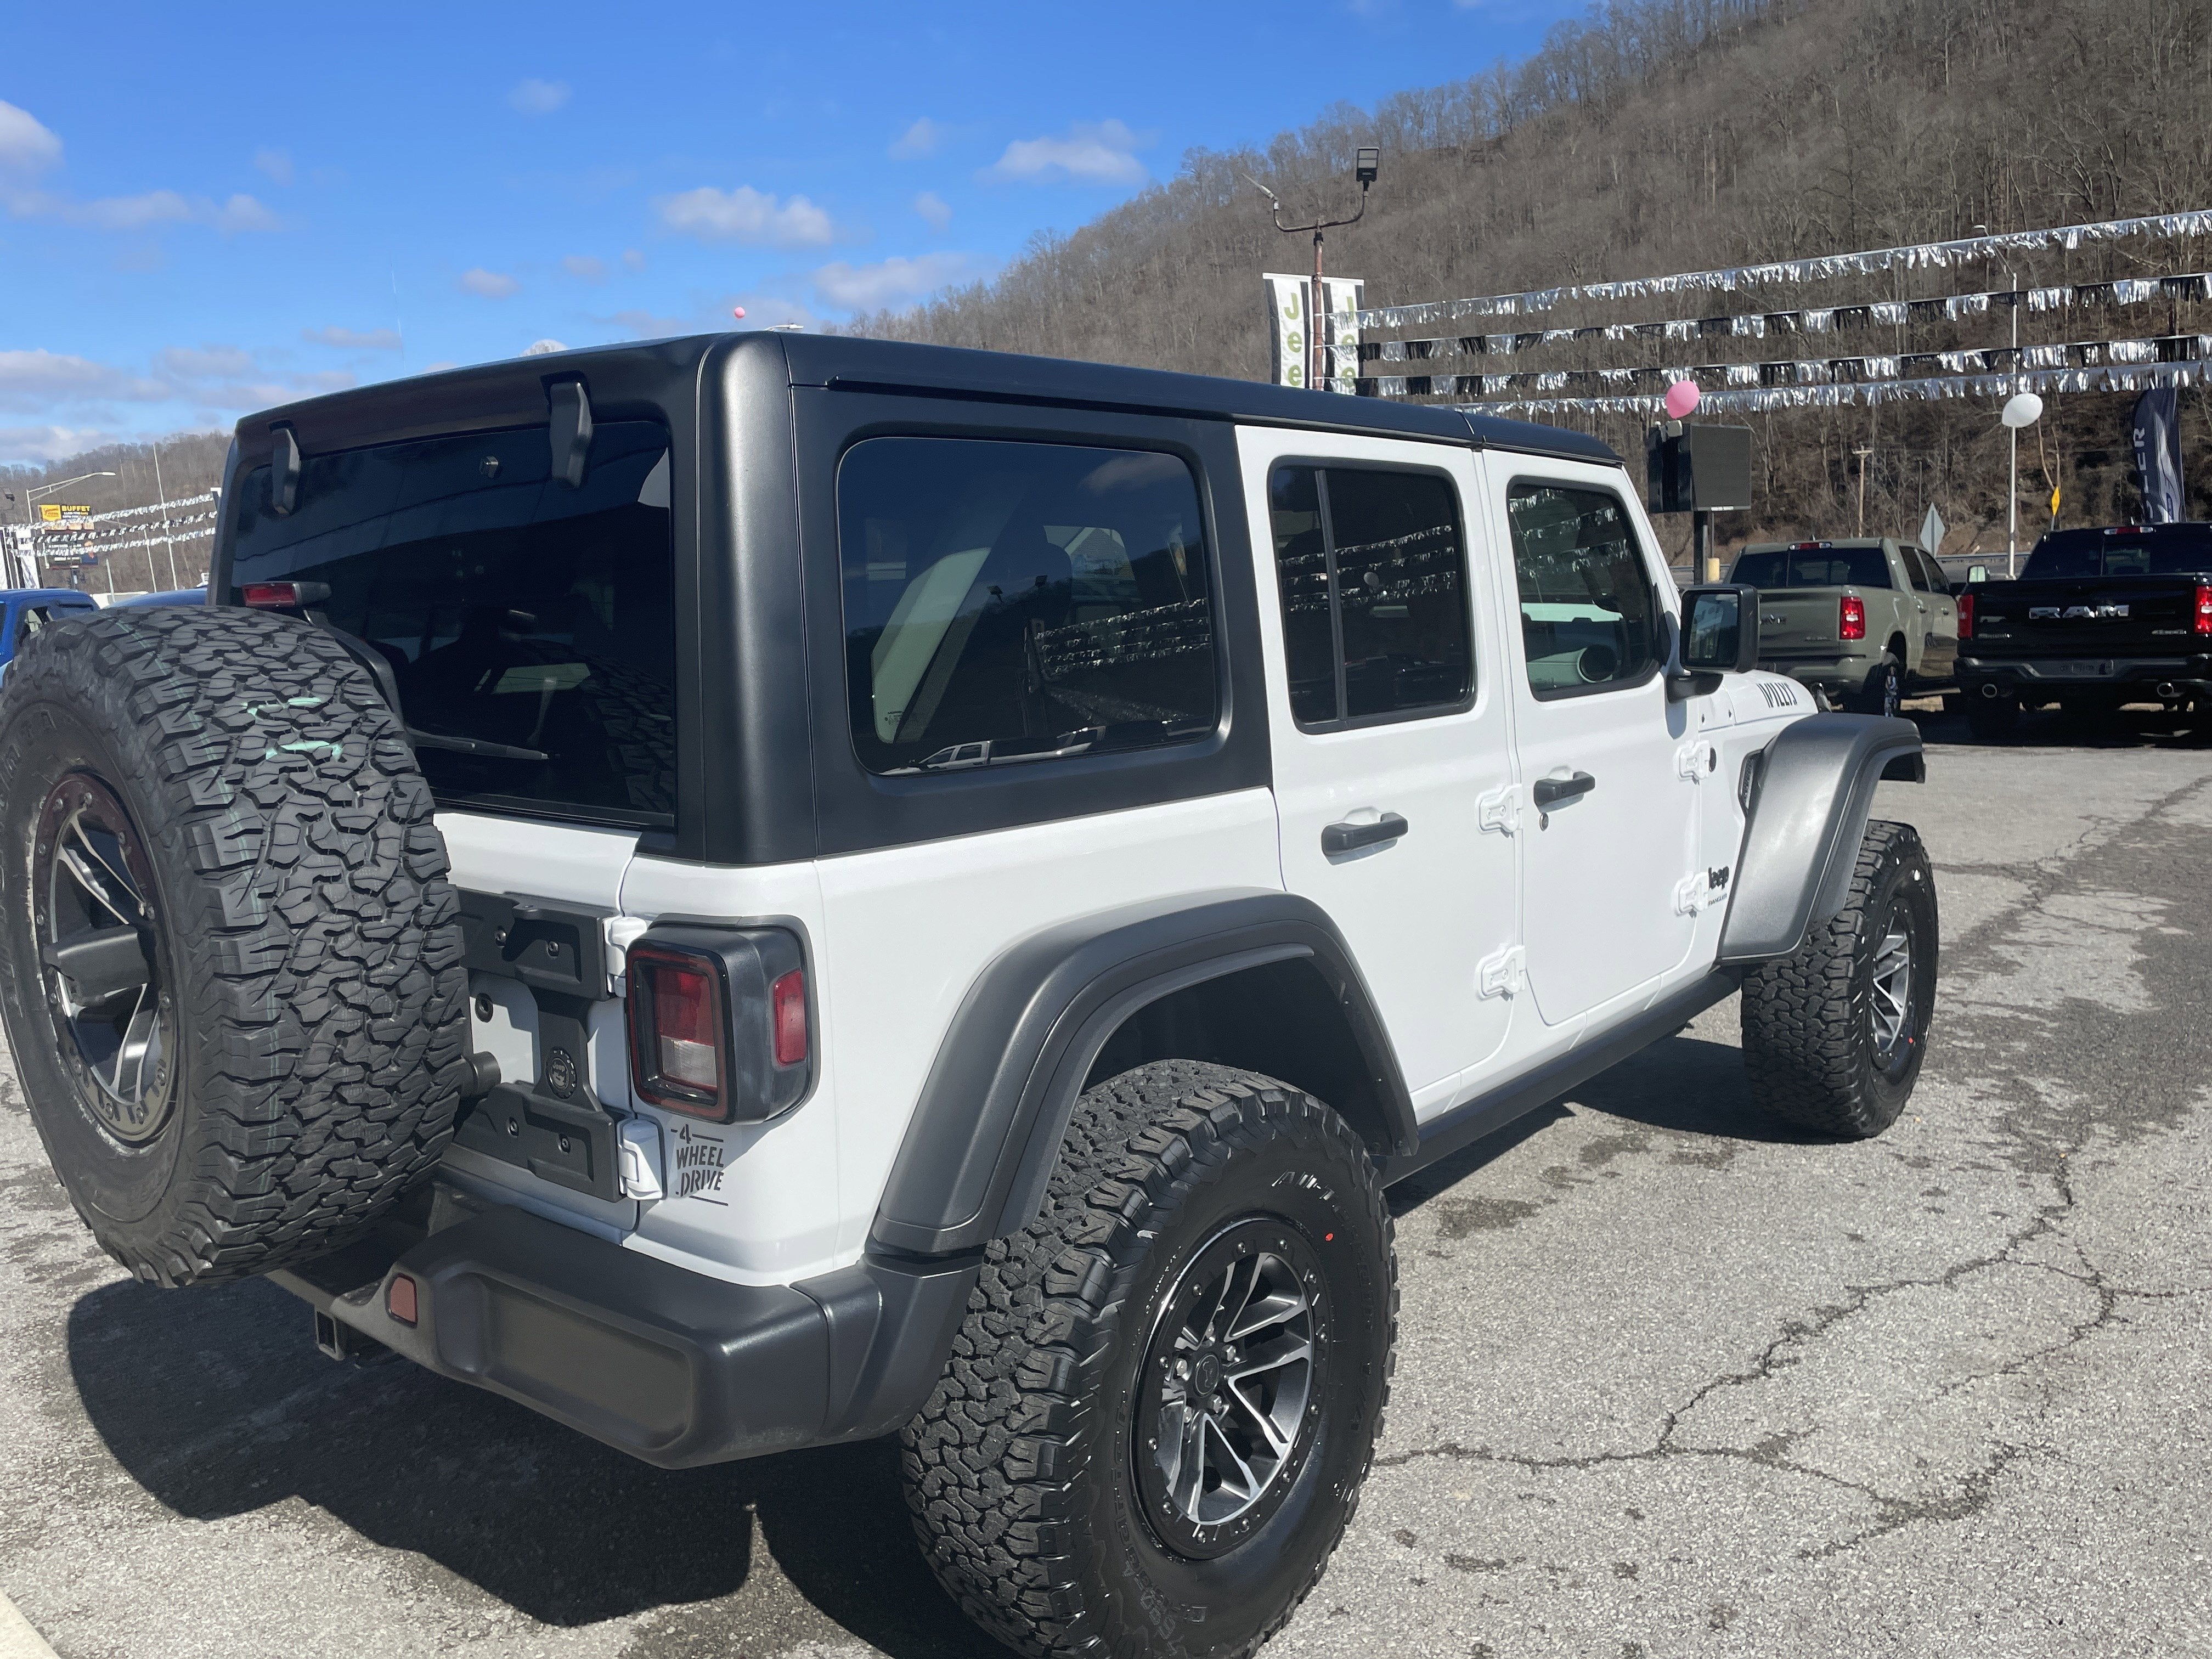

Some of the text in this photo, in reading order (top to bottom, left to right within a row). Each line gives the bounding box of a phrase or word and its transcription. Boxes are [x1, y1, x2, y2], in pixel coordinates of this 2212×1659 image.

[2029, 605, 2129, 619] RAM
[676, 1146, 724, 1170] WHEEL
[681, 1170, 724, 1197] DRIVE
